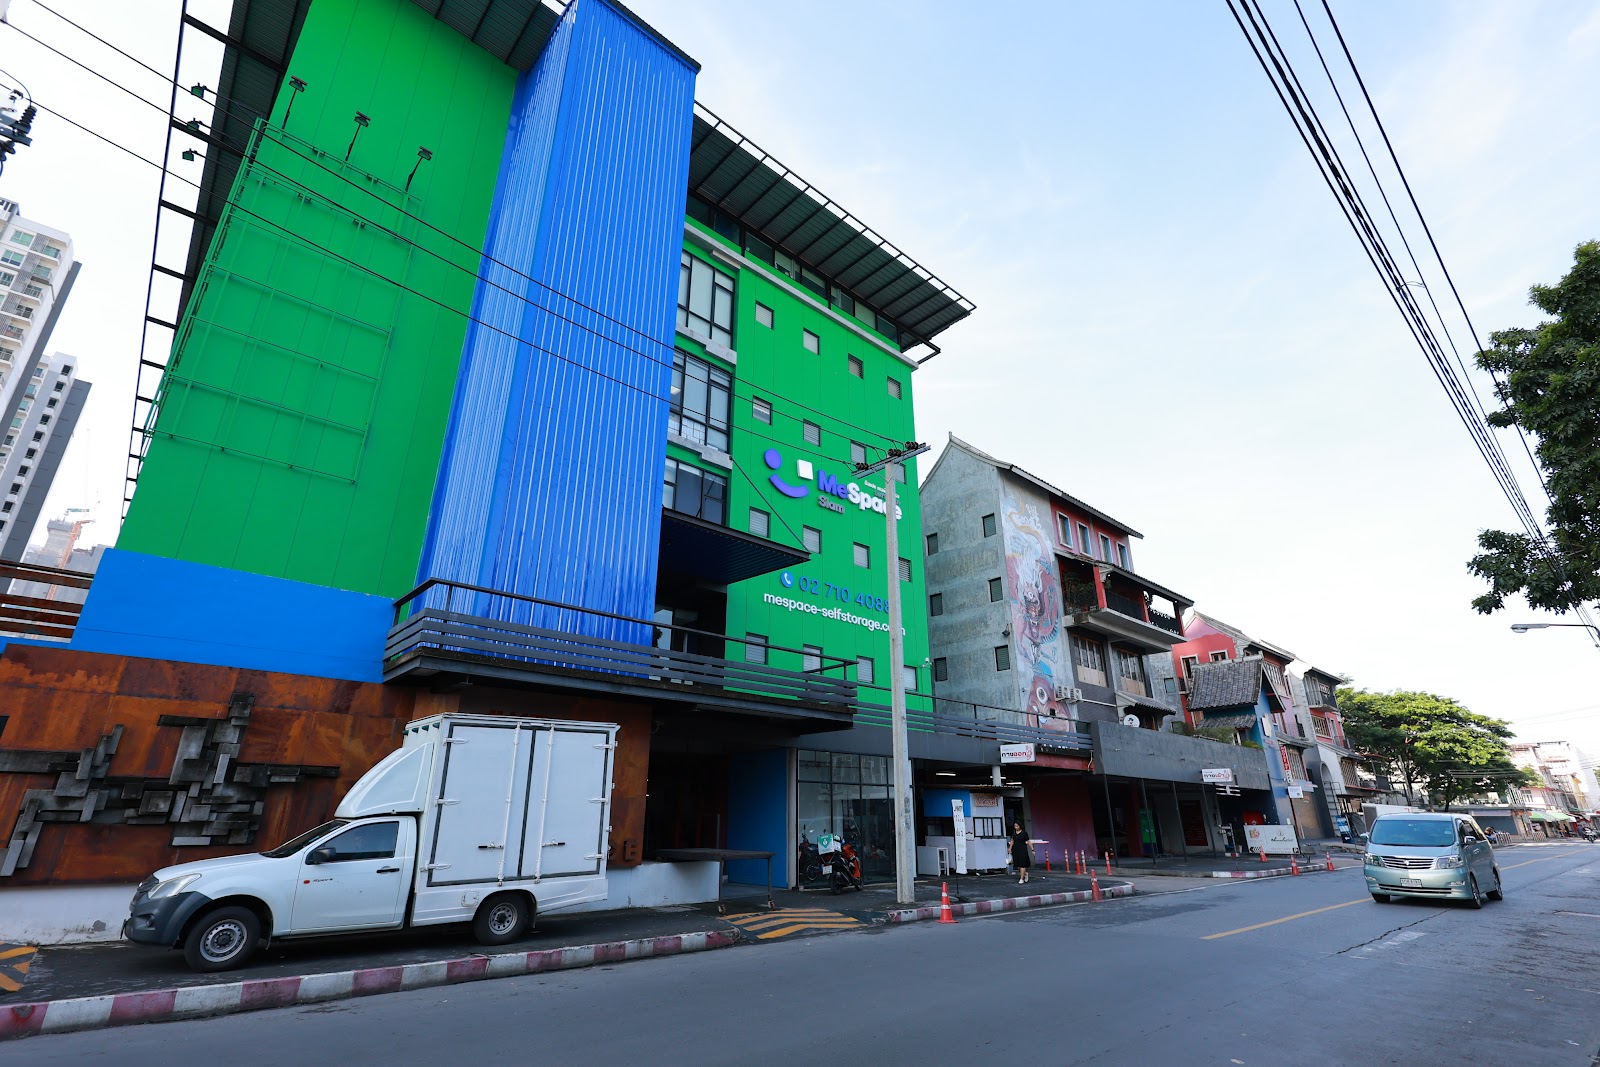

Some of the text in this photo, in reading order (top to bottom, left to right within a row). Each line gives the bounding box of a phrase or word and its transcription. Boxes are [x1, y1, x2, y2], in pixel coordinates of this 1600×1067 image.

[818, 494, 845, 514] Siam
[799, 575, 820, 595] 02
[824, 581, 851, 603] 710
